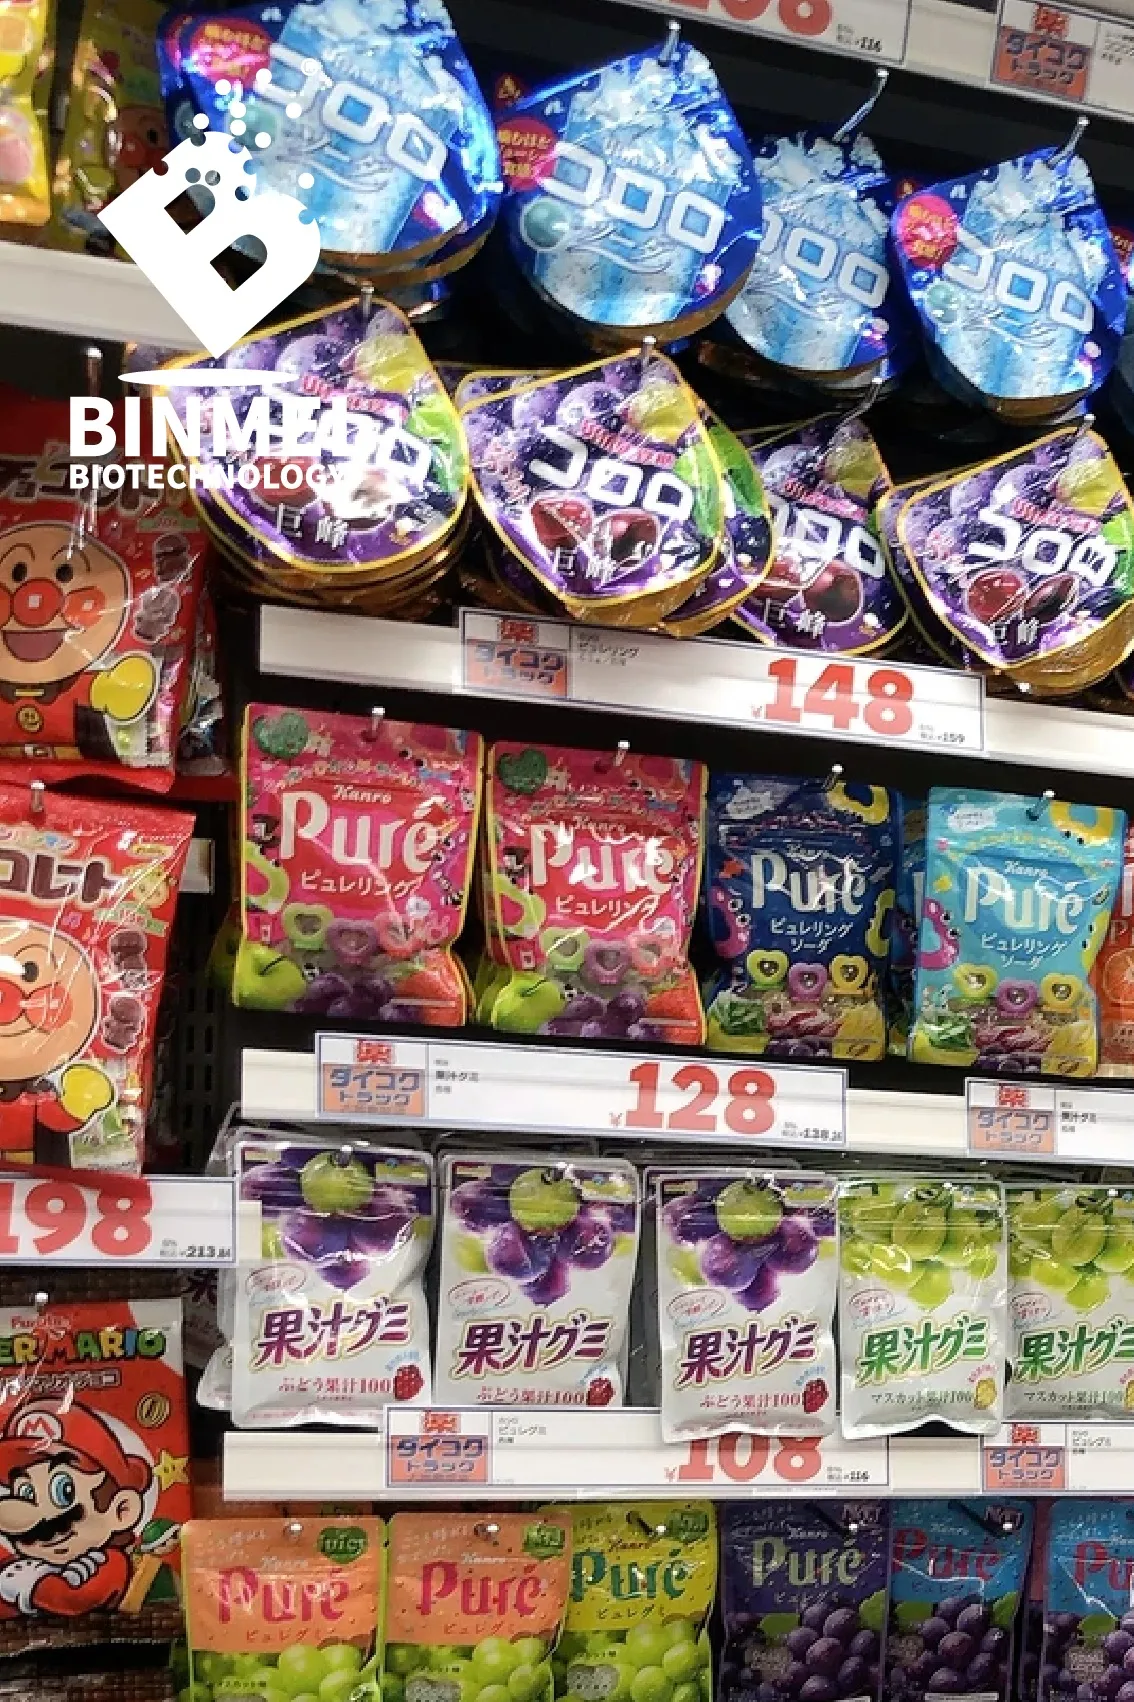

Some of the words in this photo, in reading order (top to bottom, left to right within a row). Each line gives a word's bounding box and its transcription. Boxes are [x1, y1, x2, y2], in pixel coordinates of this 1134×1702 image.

[538, 141, 725, 254] コロロ
[942, 229, 1095, 334] コロロ
[528, 423, 694, 522] コロロ
[277, 502, 349, 547] 巨峰
[967, 497, 1121, 588] コロロ
[332, 784, 392, 804] Kanro
[280, 790, 448, 874] Puré
[301, 871, 423, 900] ピュレリング
[964, 865, 1086, 935] Puré
[770, 917, 854, 938] ピュレリング
[792, 937, 833, 954] ソーダ
[980, 933, 1068, 955] ピュレリング
[329, 1067, 421, 1093] ダイコク
[976, 1110, 1051, 1131] ダイコク
[46, 1327, 167, 1363] MARIO
[254, 1295, 411, 1367] 果汁グミ
[455, 1313, 611, 1378] 果汁グミ
[677, 1315, 817, 1386] 果汁グミ
[858, 1314, 988, 1385] 果汁グミ
[396, 1438, 483, 1458] ダイコク
[988, 1449, 1060, 1468] ダイコク
[416, 1559, 542, 1616] Puré
[571, 1548, 694, 1603] Puré
[751, 1535, 863, 1589] Puré
